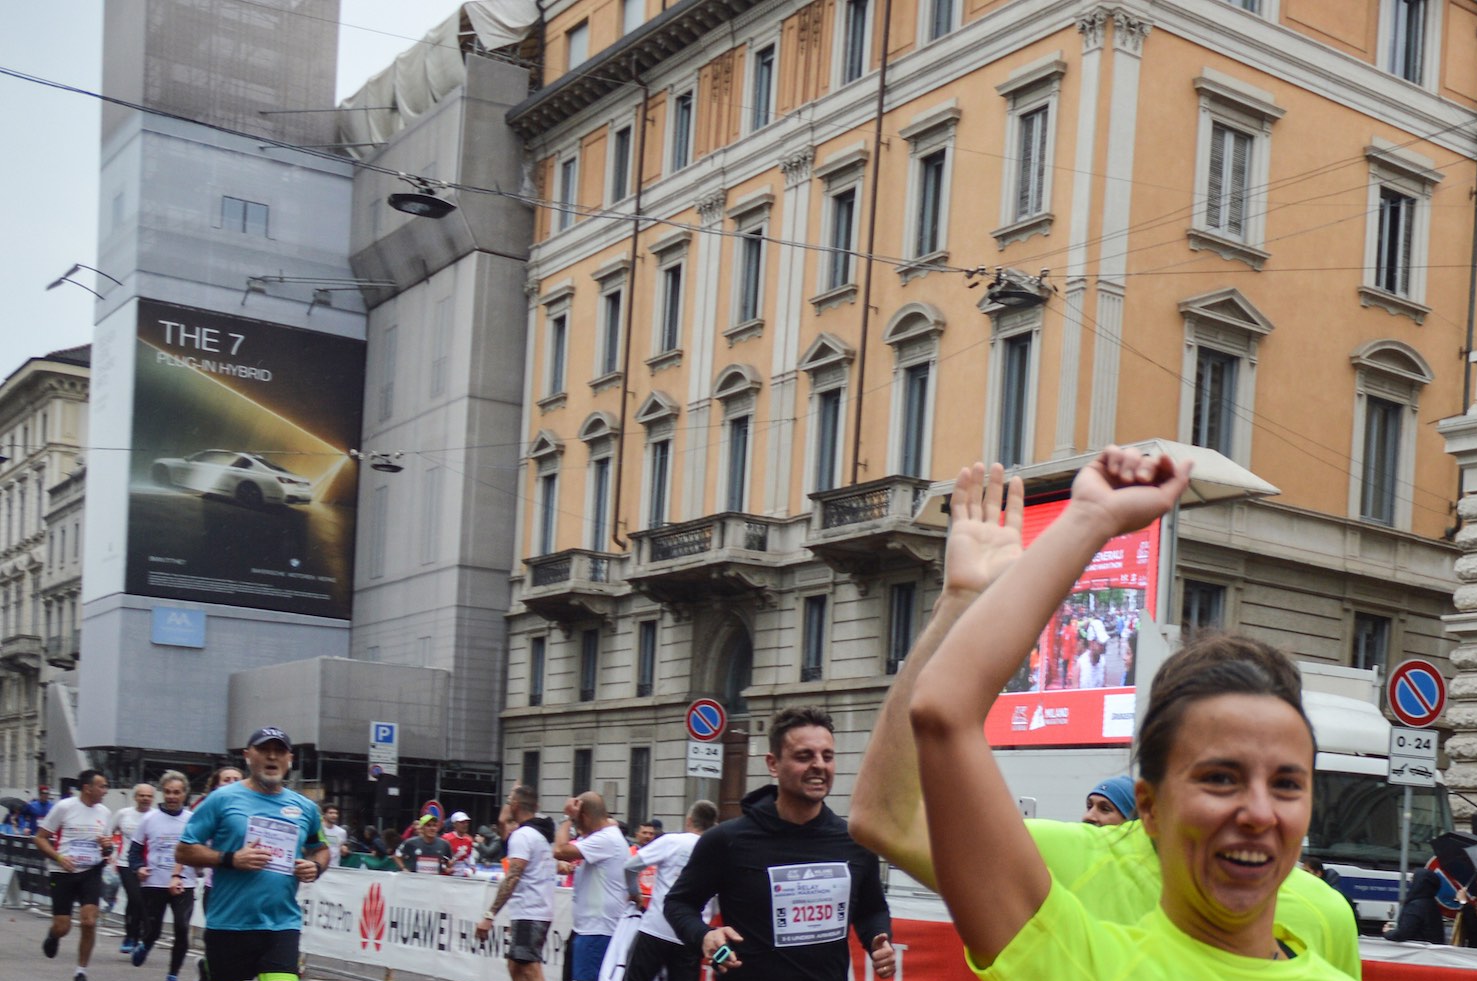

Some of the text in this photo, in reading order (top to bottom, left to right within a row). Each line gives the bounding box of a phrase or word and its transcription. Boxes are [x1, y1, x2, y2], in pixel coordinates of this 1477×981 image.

[158, 319, 245, 355] THE 7
[157, 351, 272, 382] PLUG-IN HYBRID
[389, 906, 452, 951] HUAWEI
[792, 904, 832, 923] 2123D
[459, 919, 511, 959] HUAWE
